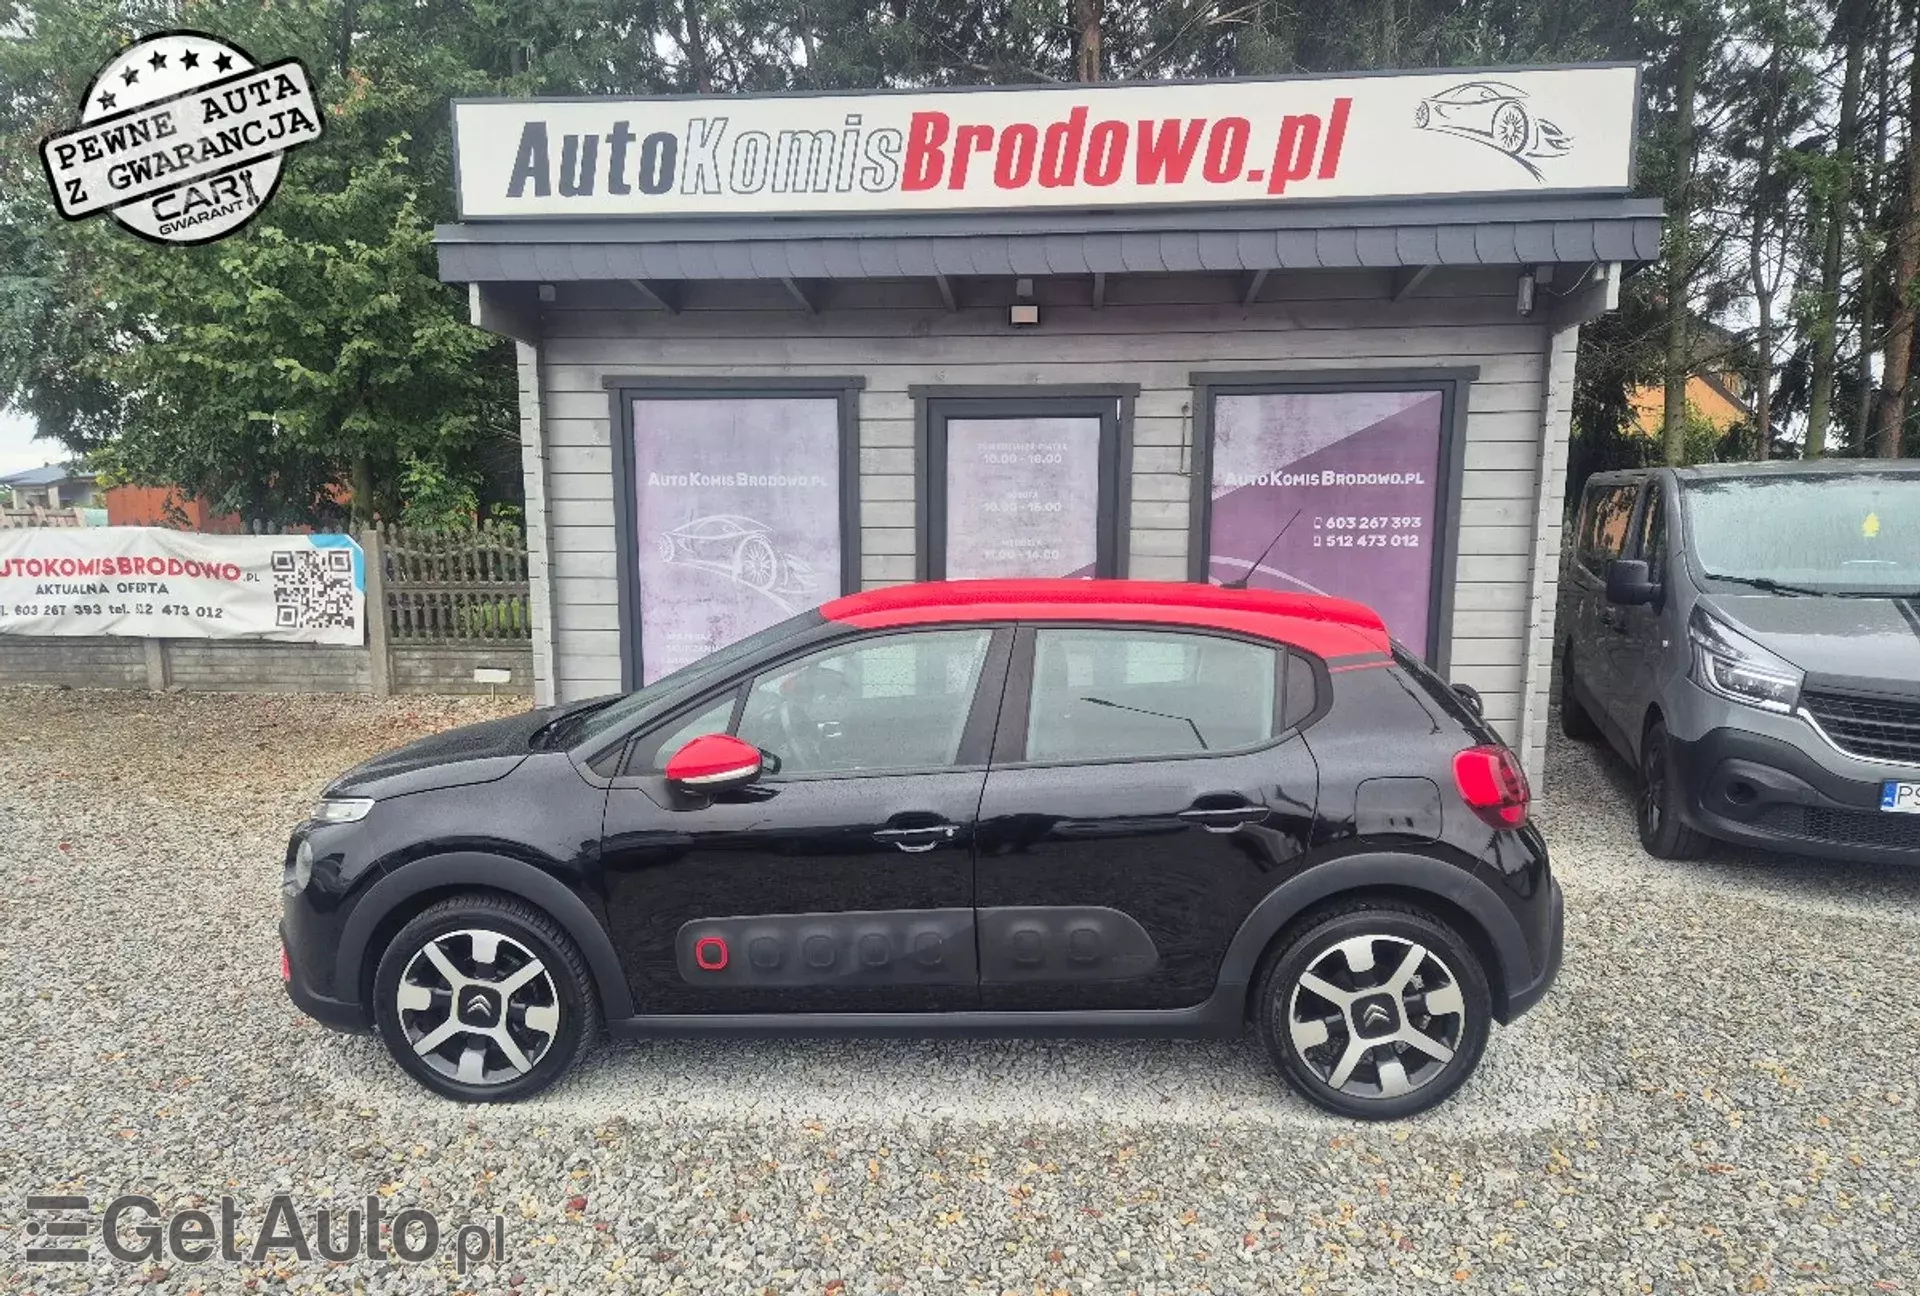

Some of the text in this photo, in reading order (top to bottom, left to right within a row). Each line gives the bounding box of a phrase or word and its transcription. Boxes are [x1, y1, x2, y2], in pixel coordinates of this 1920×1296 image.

[506, 97, 1353, 197] AutoKomisBrodowo.pl
[1325, 516, 1422, 529] 603 267 393
[1325, 534, 1419, 547] 512 473 012
[36, 582, 169, 595] AKTUALNA OFERTA
[14, 604, 38, 616] 603
[43, 604, 67, 616] 267
[74, 603, 102, 615] 393
[108, 603, 131, 614] tel.
[162, 604, 190, 616] 473
[196, 606, 224, 618] 012
